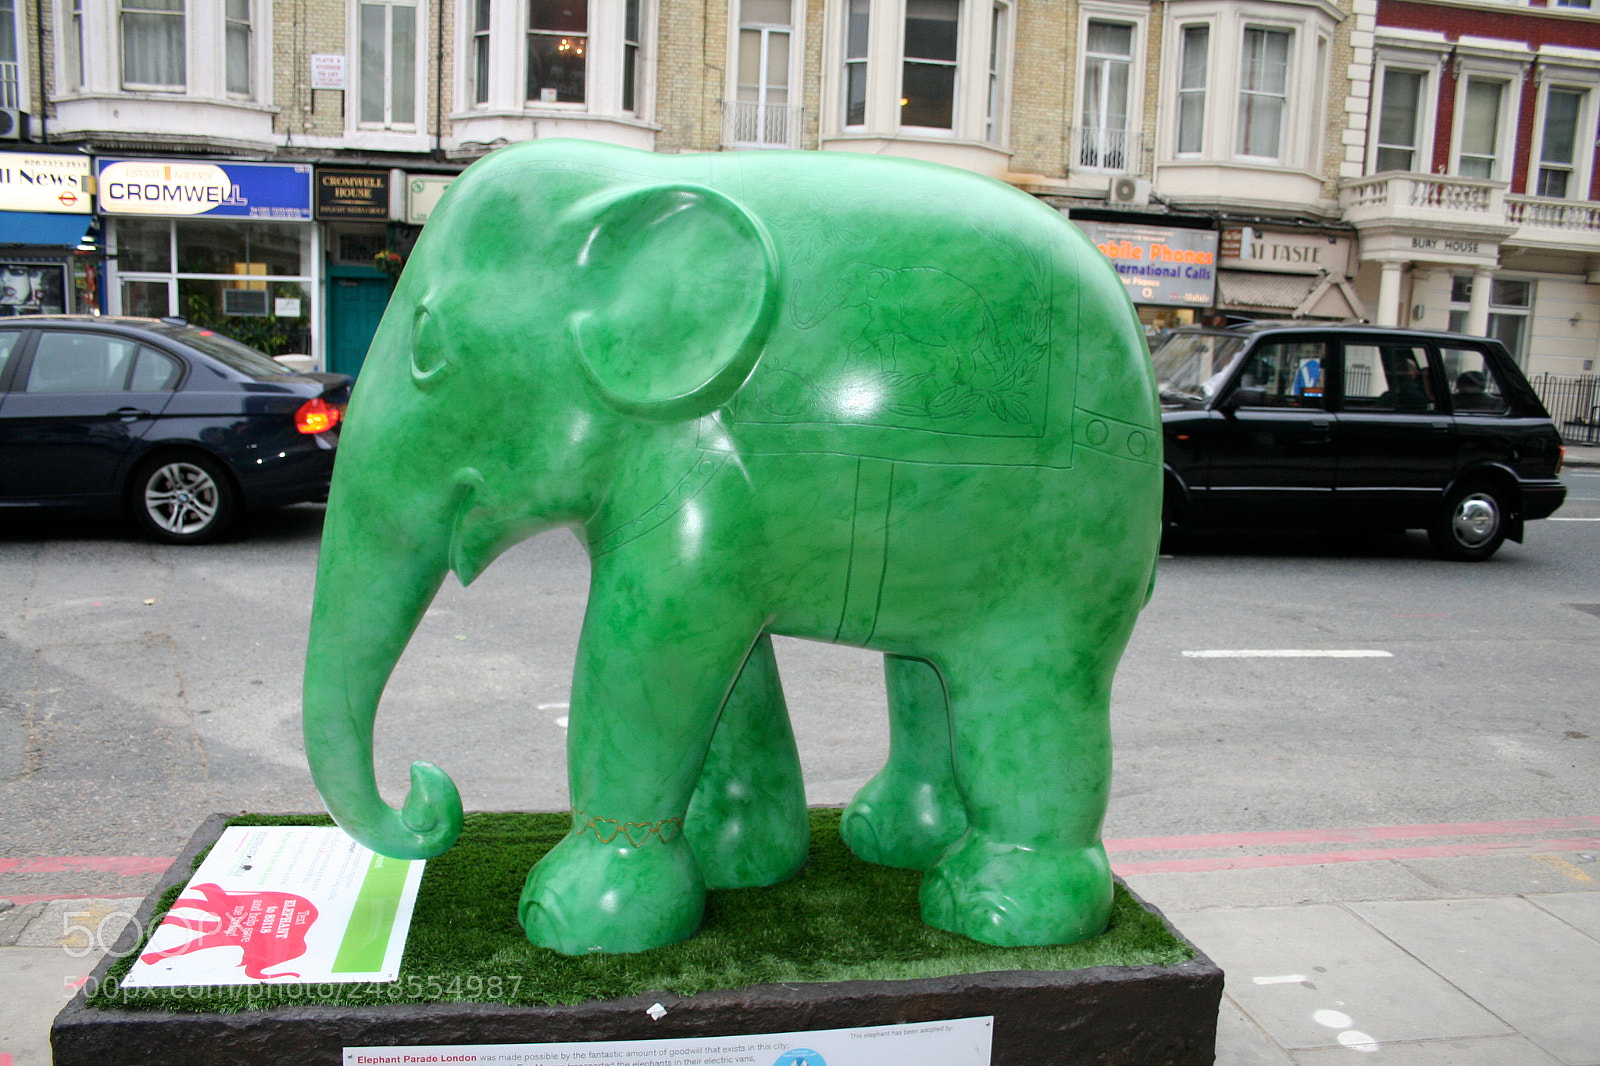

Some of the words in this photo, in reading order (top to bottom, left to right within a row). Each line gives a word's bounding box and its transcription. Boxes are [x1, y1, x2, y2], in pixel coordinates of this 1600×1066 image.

[19, 169, 78, 187] News
[322, 176, 384, 188] CROMWELL
[109, 183, 248, 206] CROMWELL
[334, 187, 373, 199] HOUSE
[1090, 238, 1143, 261] obile
[1149, 243, 1214, 265] Phones
[1272, 244, 1322, 265] TASTE
[1411, 238, 1437, 249] BURY
[1444, 241, 1479, 254] HOUSE
[1114, 262, 1181, 278] ternational
[1185, 266, 1211, 280] Calls
[276, 899, 297, 939] ELEPHANT
[850, 1032, 862, 1040] This
[864, 1031, 890, 1039] elephant
[919, 1026, 944, 1035] adopted
[357, 1056, 401, 1064] Elephant
[403, 1055, 438, 1063] Parade
[440, 1054, 477, 1062] London
[498, 1053, 522, 1061] made
[524, 1051, 558, 1062] possible
[560, 1051, 569, 1060] by
[573, 1050, 586, 1058] the
[588, 1048, 622, 1058] fantastic
[625, 1049, 656, 1058] amount
[658, 1047, 666, 1056] of
[669, 1045, 702, 1058] goodwill
[704, 1045, 720, 1054] that
[722, 1044, 745, 1053] exists
[747, 1043, 754, 1052] in
[757, 1042, 771, 1051] this
[674, 1056, 681, 1065] in
[684, 1055, 701, 1064] their
[704, 1054, 732, 1063] electric
